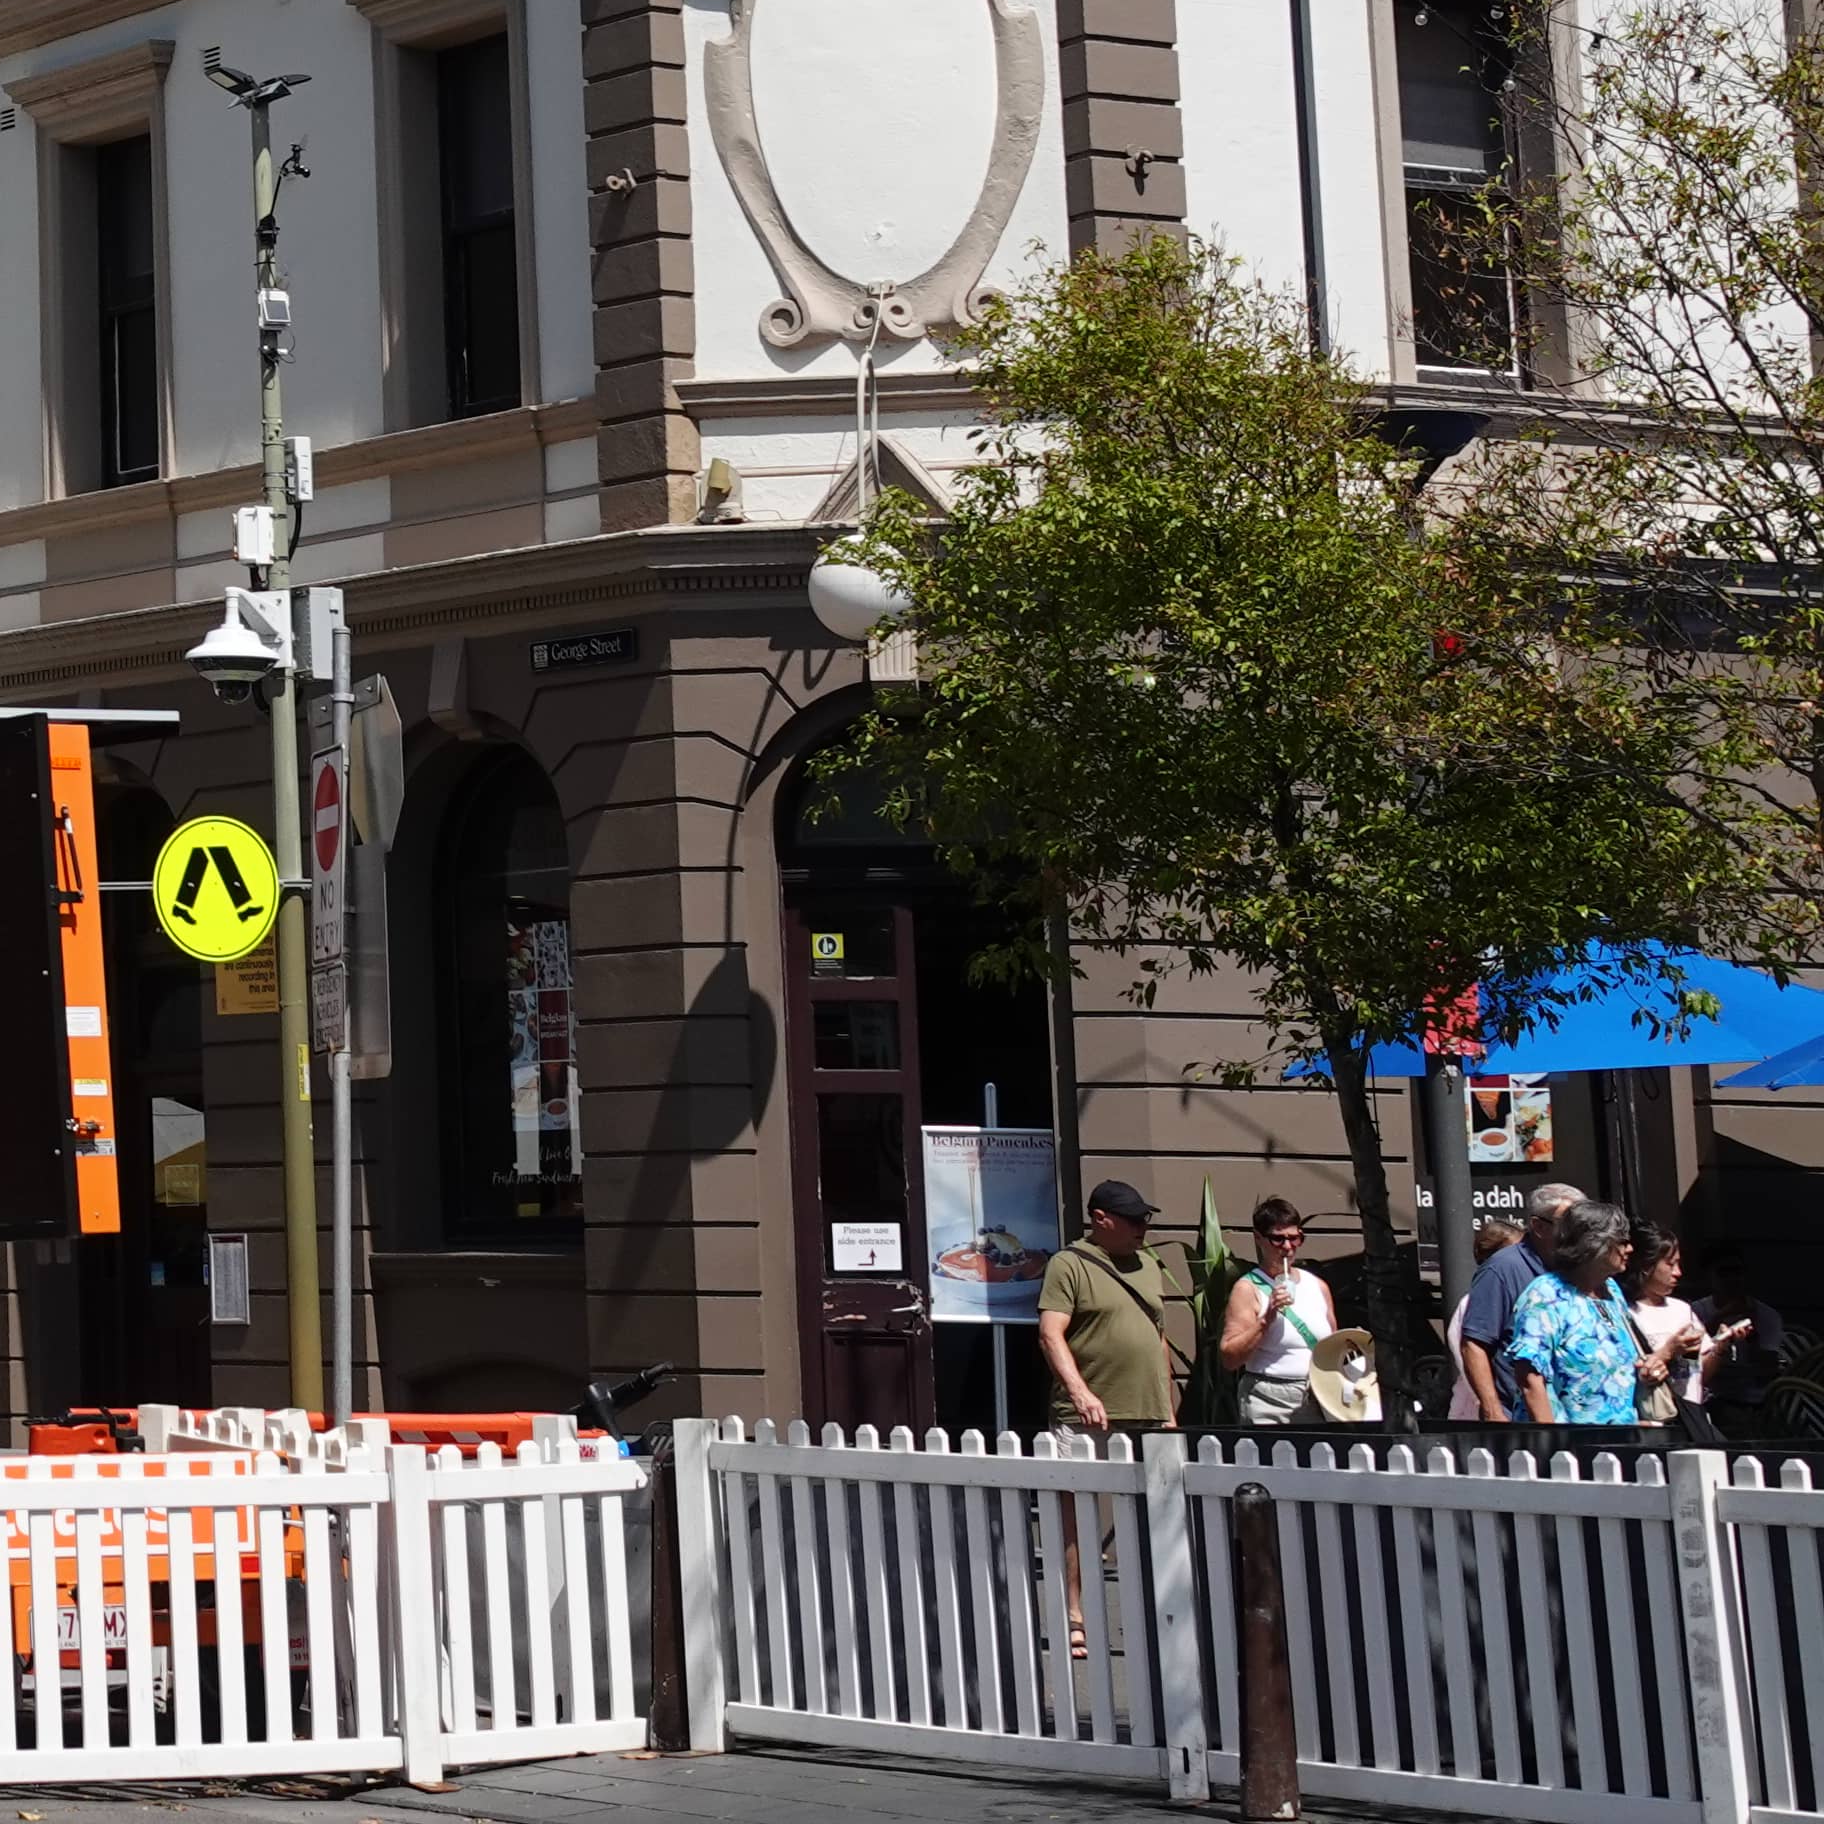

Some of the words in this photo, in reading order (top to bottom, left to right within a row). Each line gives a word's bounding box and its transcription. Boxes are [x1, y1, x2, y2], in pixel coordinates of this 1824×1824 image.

[552, 643, 588, 661] George
[590, 636, 622, 656] Street
[320, 879, 335, 912] NO
[315, 920, 340, 951] ENTRY
[931, 1134, 984, 1149] Belgian
[987, 1135, 1054, 1150] Pancakes
[843, 1225, 871, 1234] Please
[837, 1237, 856, 1245] side
